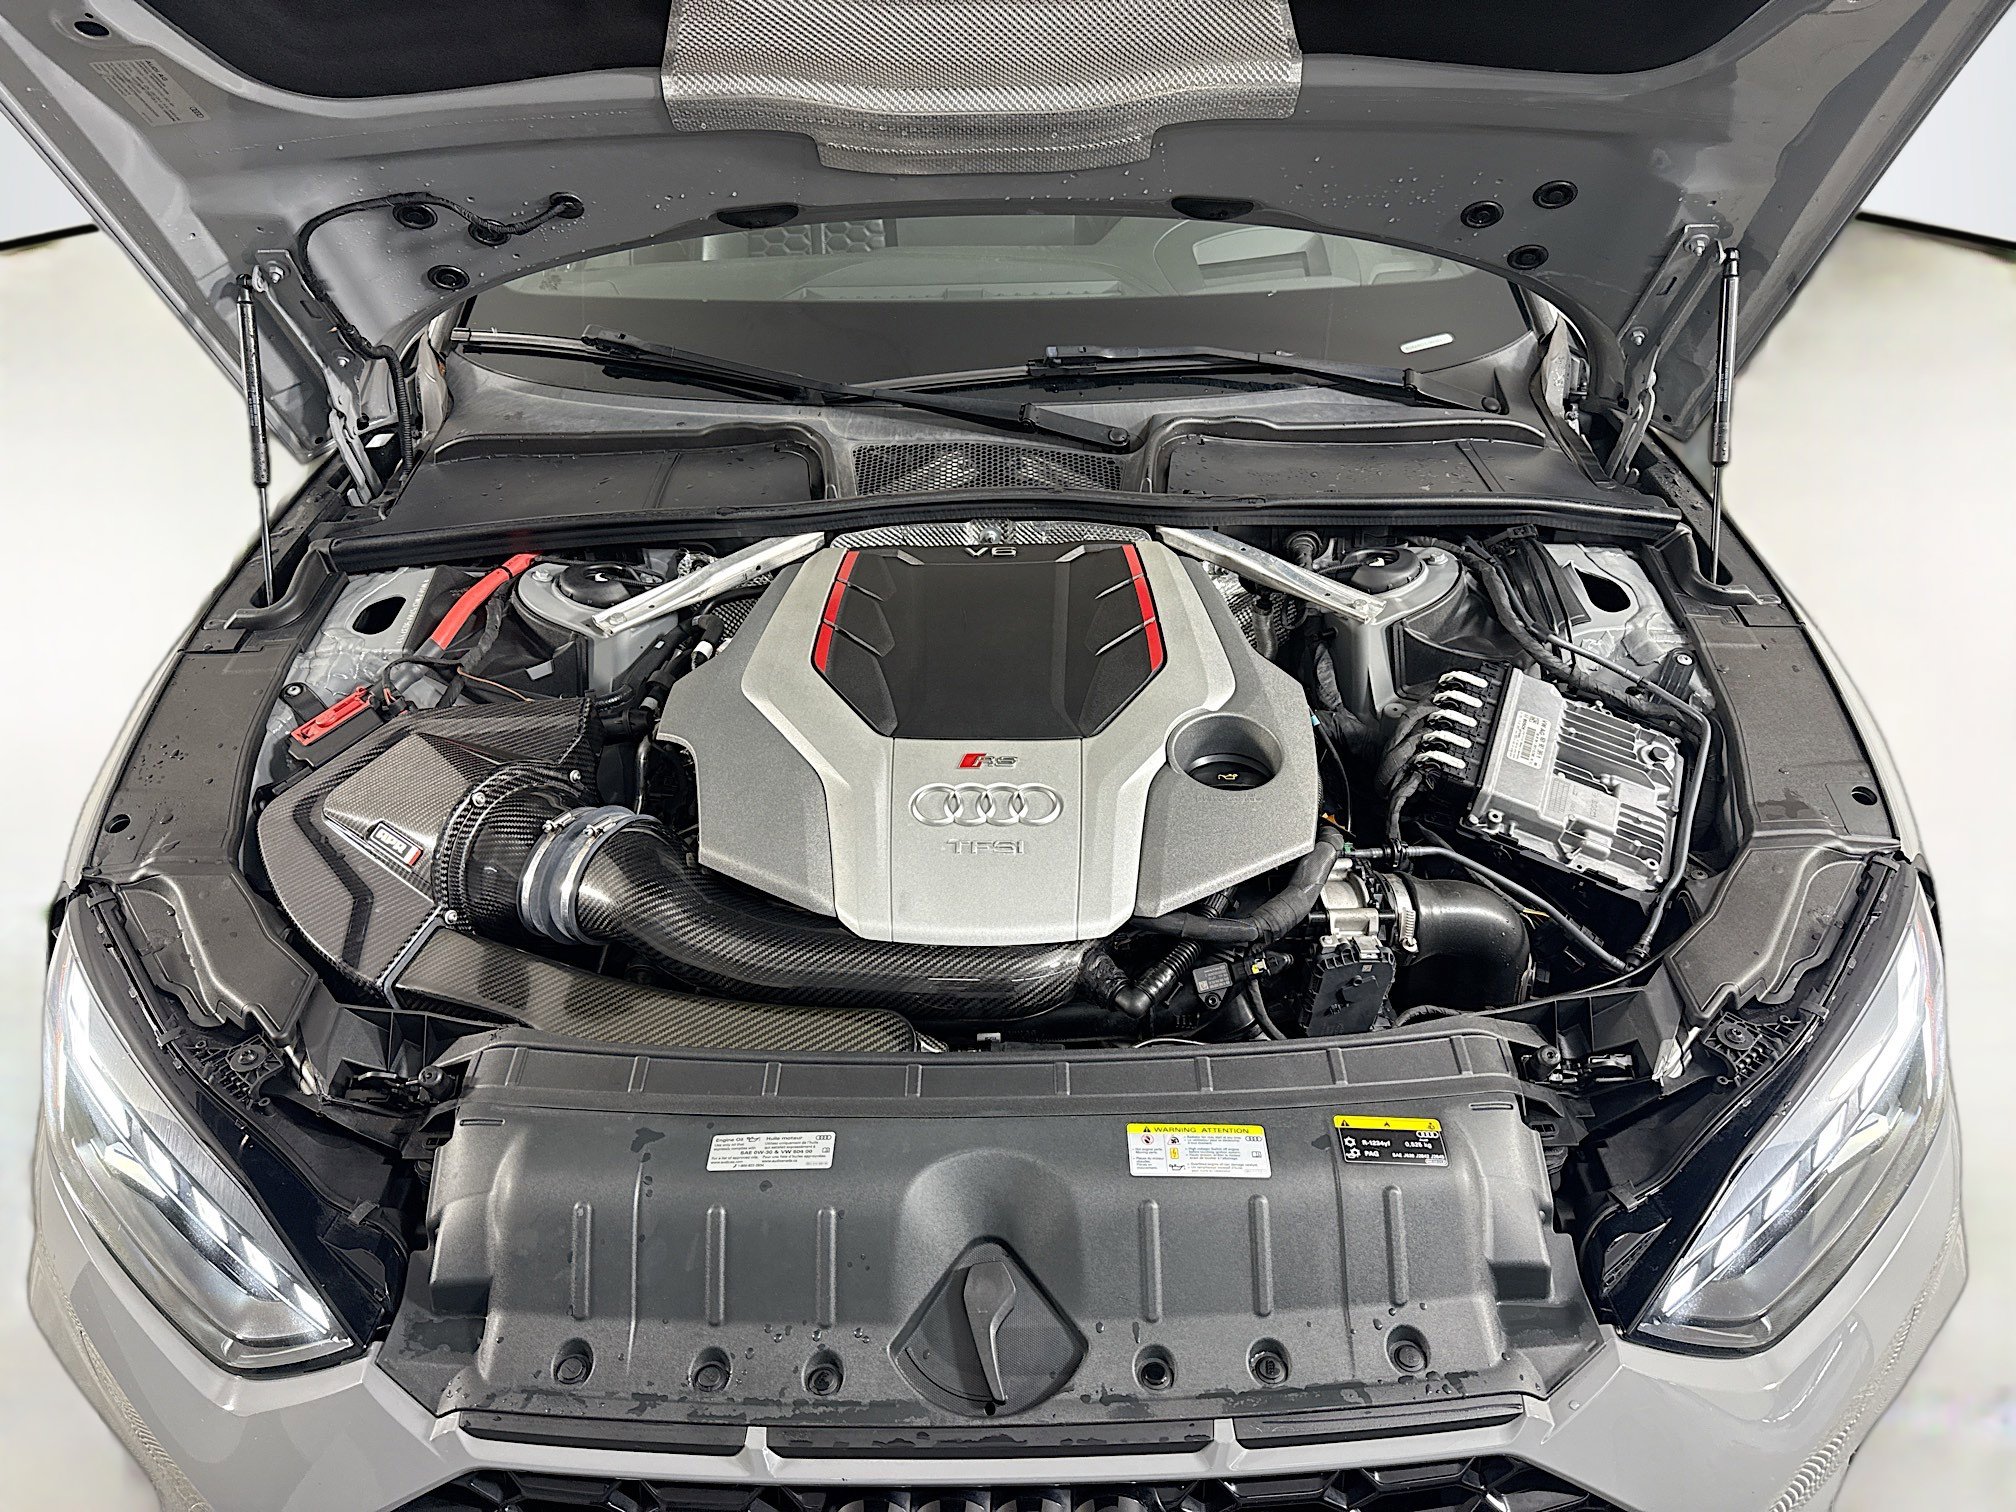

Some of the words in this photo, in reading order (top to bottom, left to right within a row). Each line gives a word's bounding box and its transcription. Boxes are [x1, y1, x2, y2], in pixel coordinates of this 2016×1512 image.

[964, 546, 1017, 557] V6
[971, 755, 1018, 768] RS
[375, 827, 408, 855] APR
[946, 838, 1025, 855] TFSI
[1423, 1142, 1433, 1150] kg
